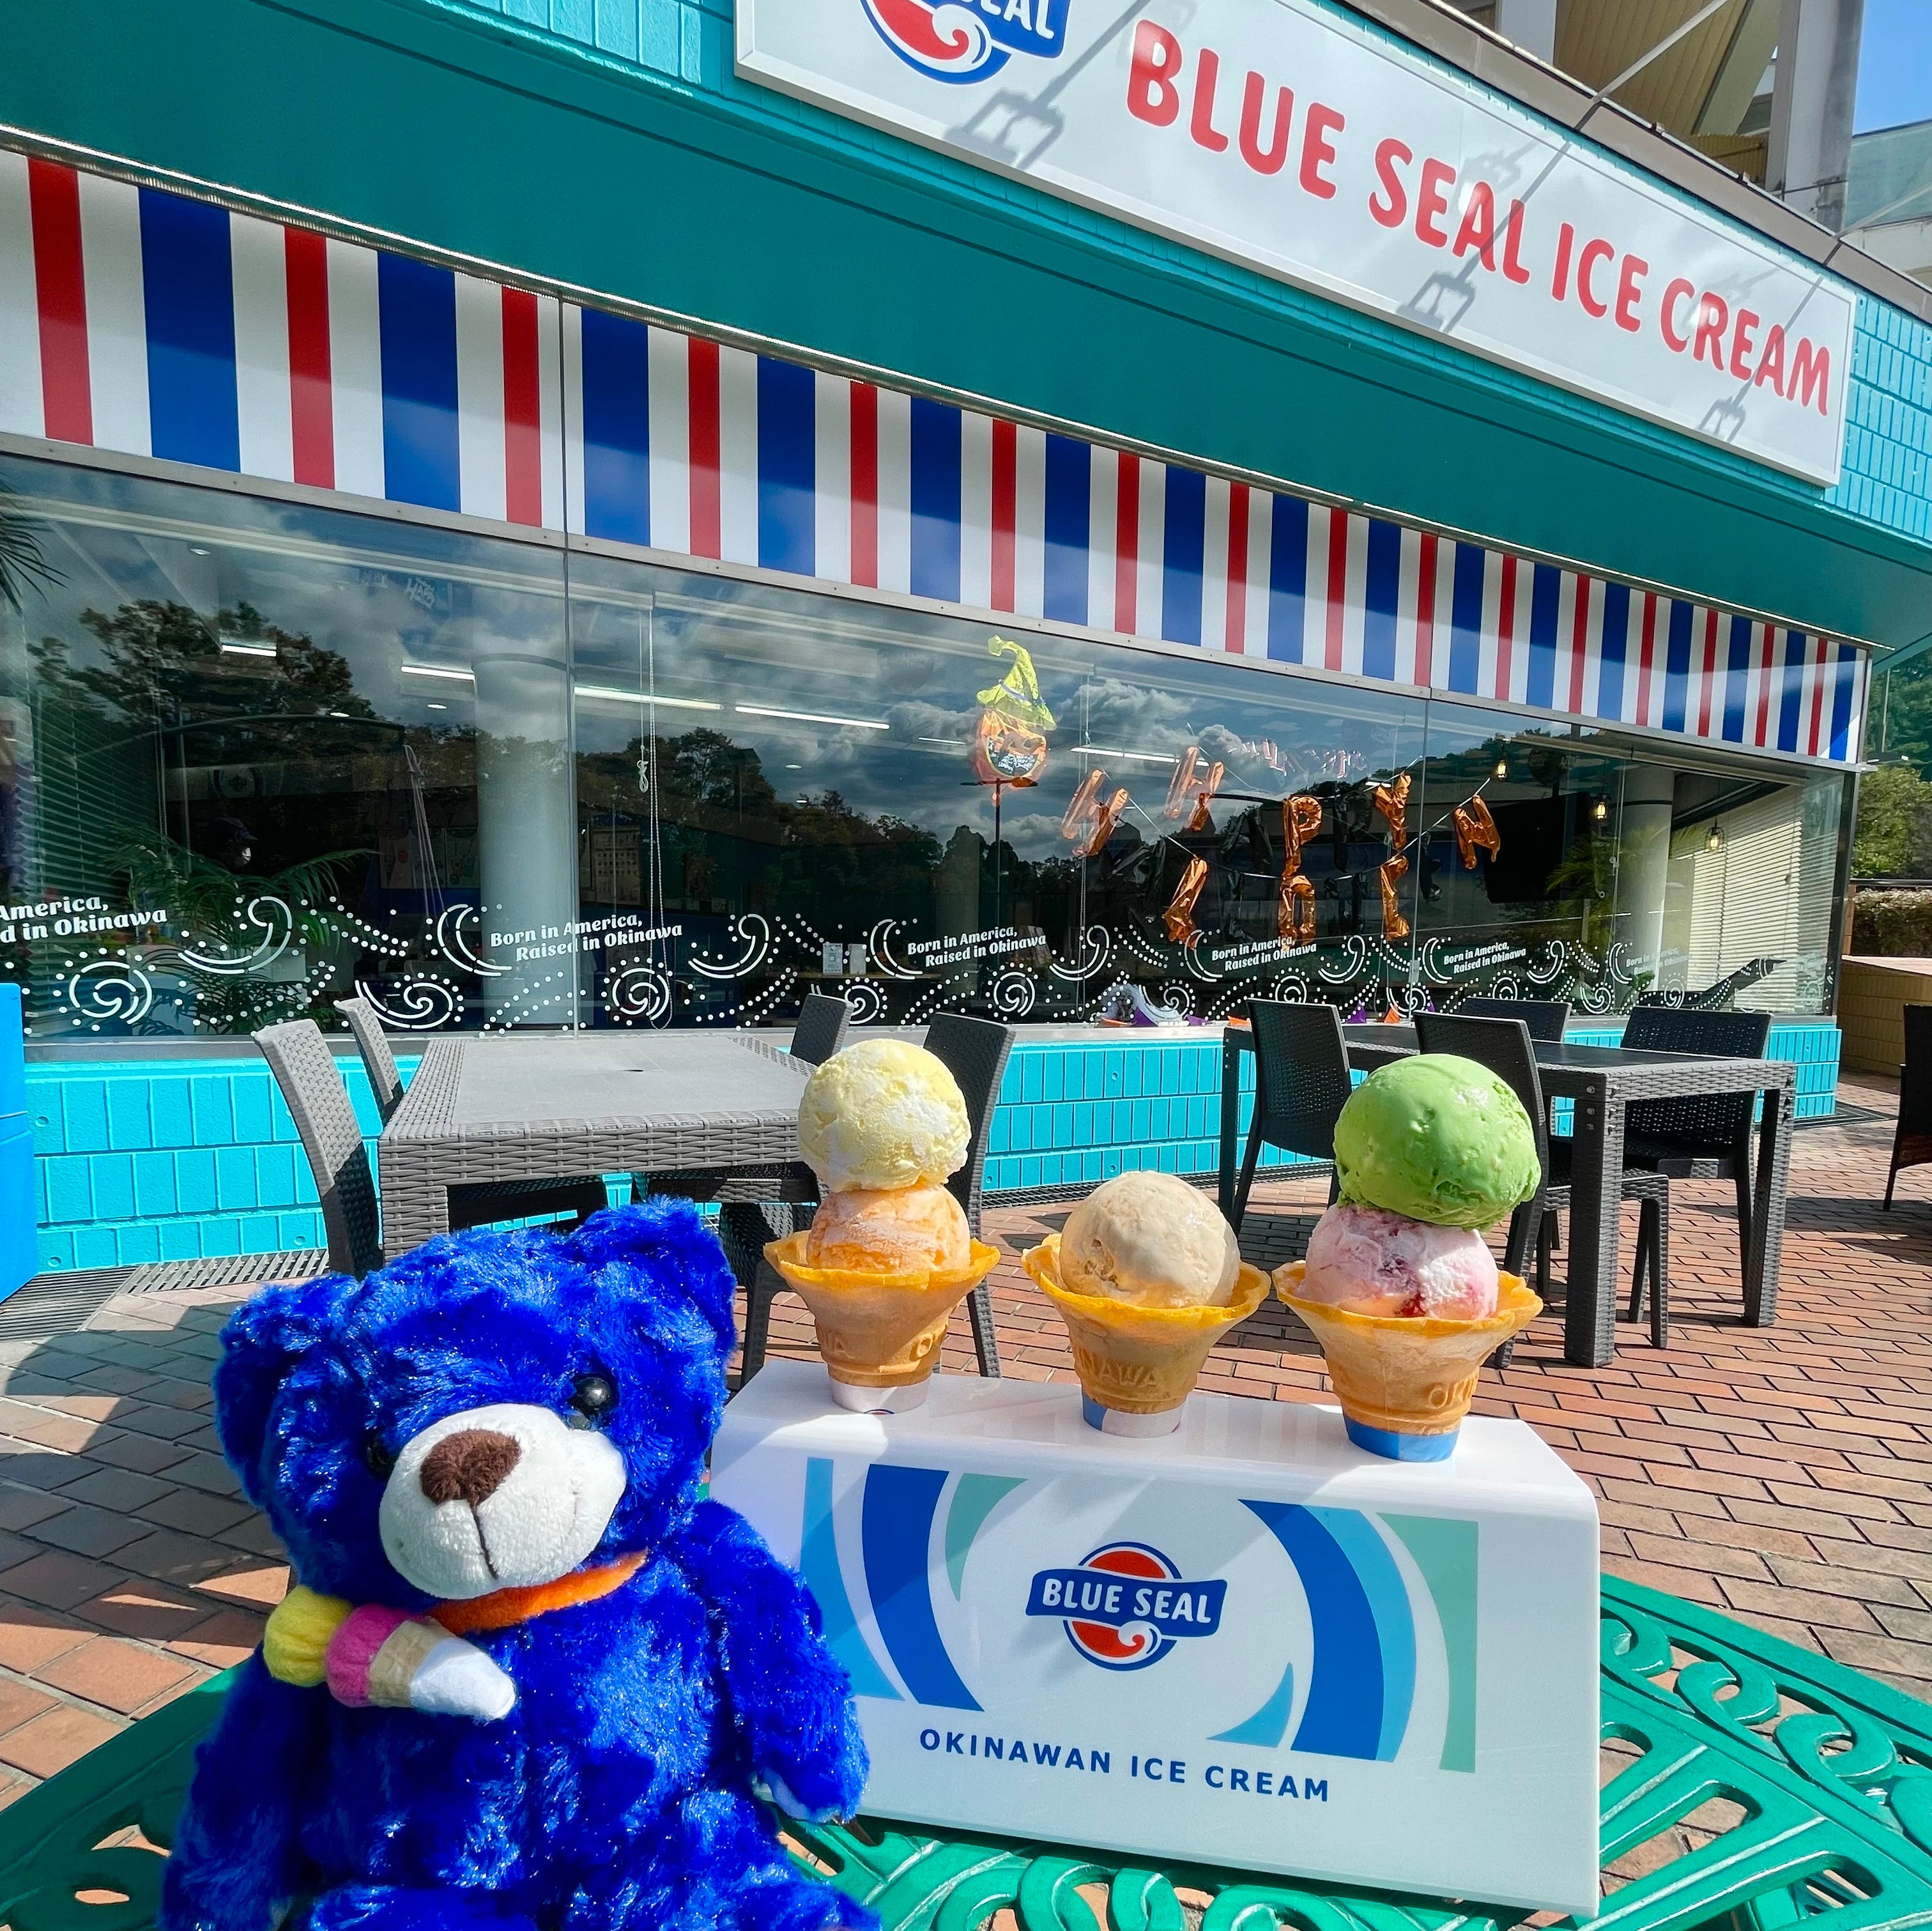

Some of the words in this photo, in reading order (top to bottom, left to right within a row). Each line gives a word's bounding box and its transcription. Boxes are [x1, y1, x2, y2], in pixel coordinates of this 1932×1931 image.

[956, 0, 1054, 40] AL
[1126, 19, 1345, 199] BLUE
[1368, 138, 1531, 284] SEAL
[1552, 222, 1650, 333] ICE
[1660, 278, 1831, 416] CREAM
[0, 896, 109, 921] America,
[22, 922, 49, 940] in
[54, 908, 167, 936] Okinawa
[490, 929, 537, 947] Born
[541, 924, 559, 939] in
[564, 913, 643, 936] America,
[516, 937, 578, 961] Raised
[583, 936, 601, 950] in
[604, 925, 682, 947] Okinawa
[907, 939, 941, 956] Born
[944, 935, 957, 949] in
[959, 926, 1018, 945] America,
[925, 947, 971, 967] Raised
[973, 945, 986, 958] in
[989, 935, 1046, 954] Okinawa
[1211, 947, 1237, 961] Born
[1239, 944, 1250, 956] in
[1250, 936, 1295, 952] America,
[1225, 954, 1259, 971] Raised
[1261, 952, 1271, 963] in
[1273, 943, 1317, 961] Okinawa
[1443, 953, 1464, 965] Born
[1465, 949, 1473, 959] in
[1453, 958, 1481, 974] Raised
[1482, 956, 1491, 966] in
[1491, 948, 1526, 964] Okinawa
[1043, 1578, 1121, 1613] BLUE
[1133, 1588, 1212, 1624] SEAL
[920, 1729, 1110, 1774] OKINAWAN
[1131, 1755, 1186, 1784] ICE
[1205, 1766, 1329, 1802] CREAM
